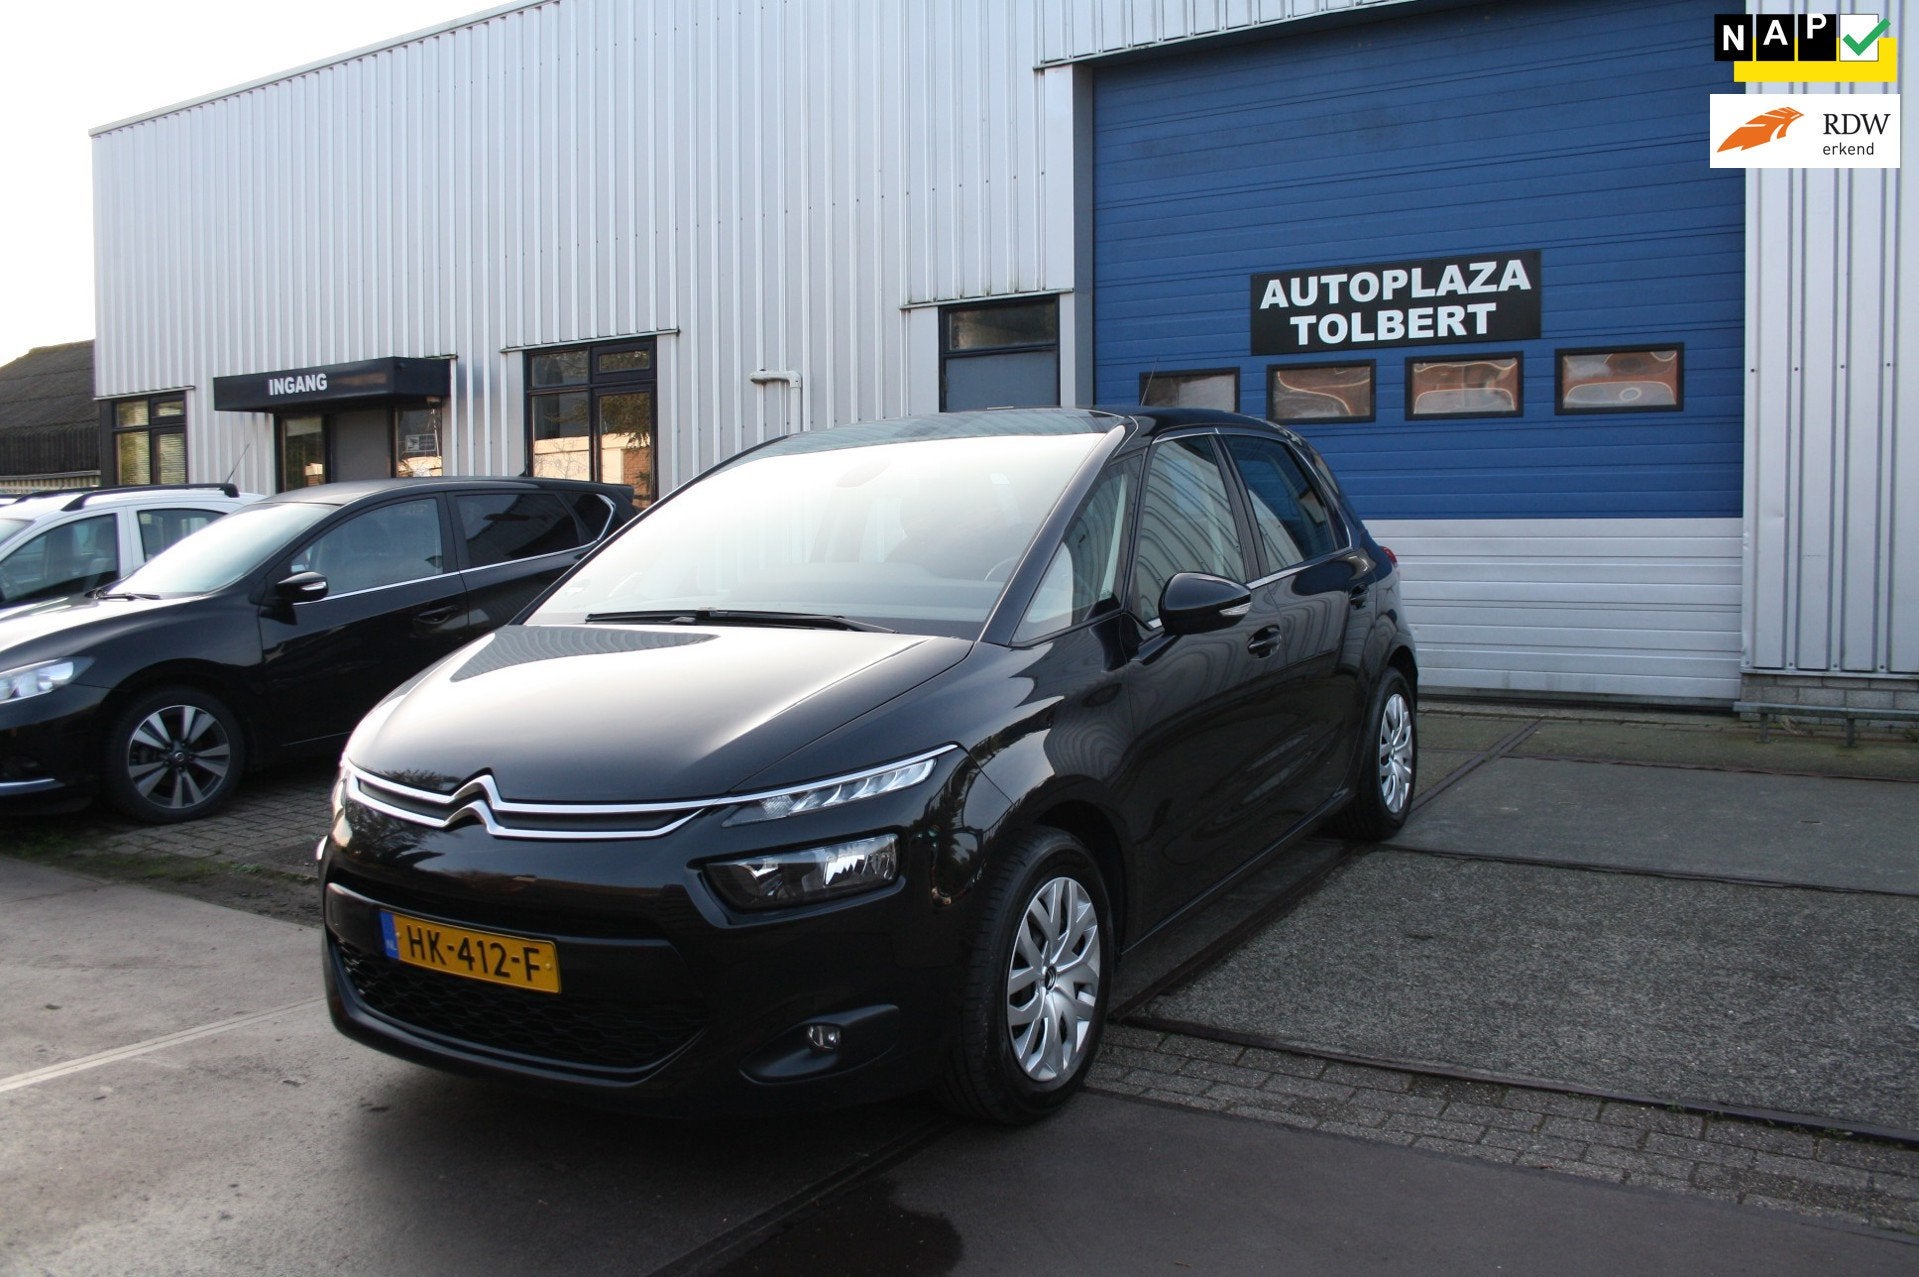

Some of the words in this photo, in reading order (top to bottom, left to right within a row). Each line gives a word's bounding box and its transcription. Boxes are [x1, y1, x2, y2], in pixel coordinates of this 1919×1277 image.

[1259, 259, 1532, 309] AUTOPLAZA
[1290, 302, 1497, 346] TOLBERT
[268, 373, 328, 396] INGANG
[406, 924, 541, 982] HK-412-F
